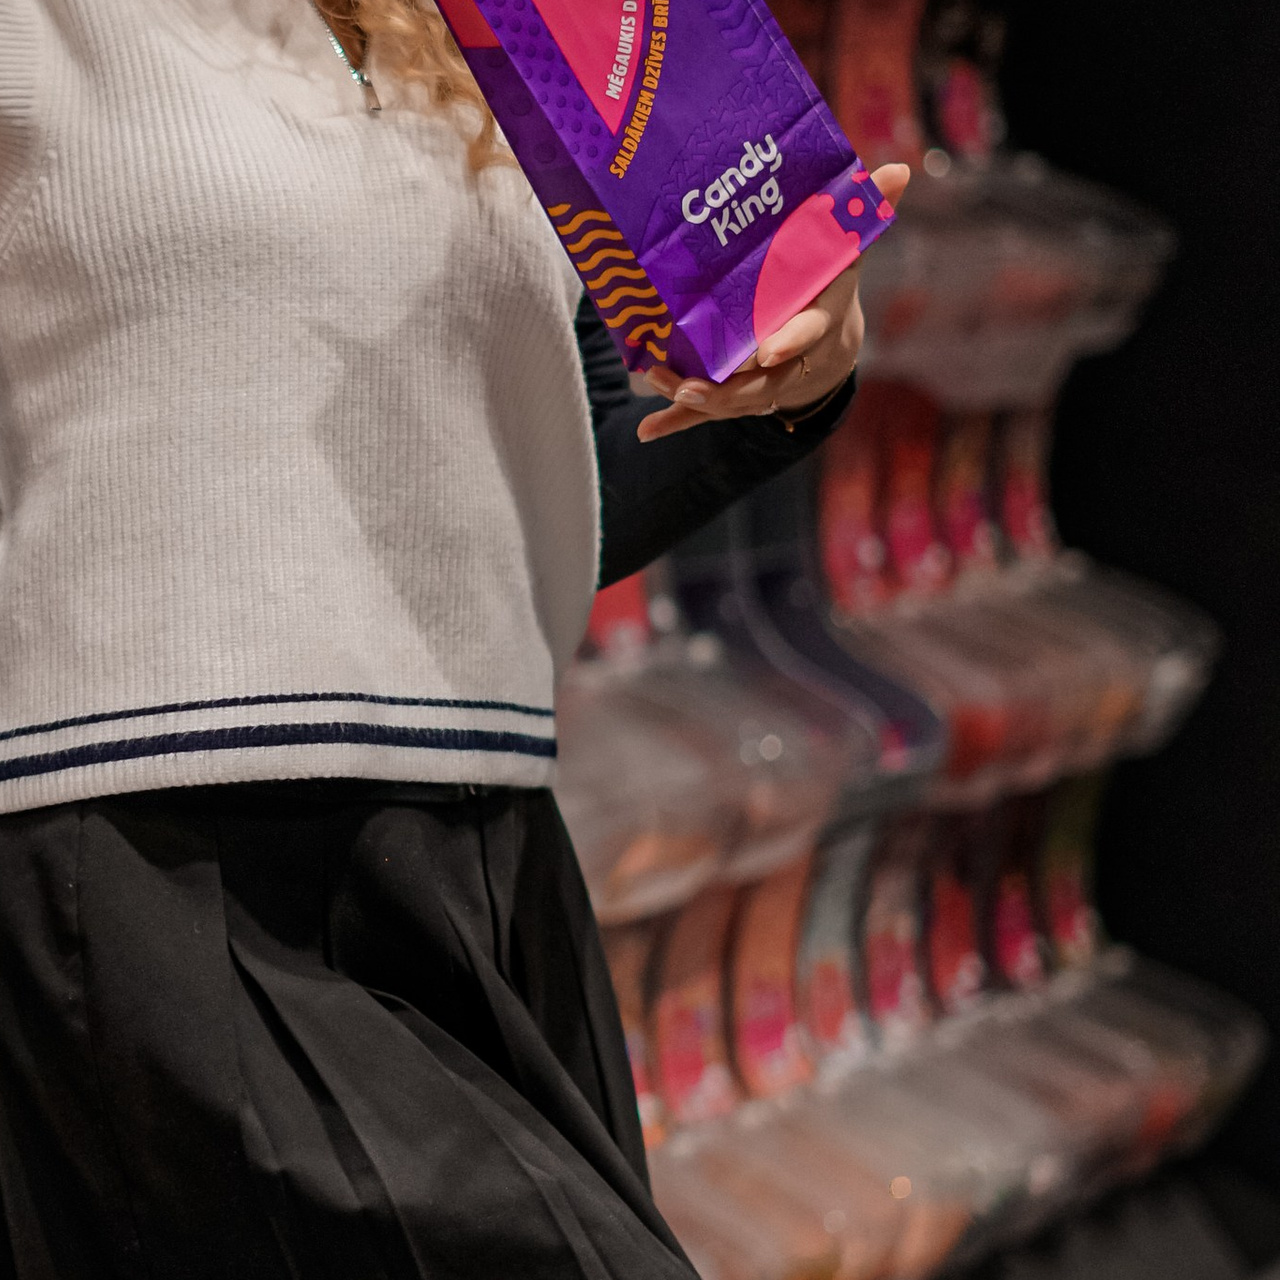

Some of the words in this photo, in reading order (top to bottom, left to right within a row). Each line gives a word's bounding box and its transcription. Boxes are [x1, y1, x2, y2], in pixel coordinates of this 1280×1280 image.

[606, 16, 636, 100] MĖGAUKIS
[610, 93, 656, 179] SALDĀKIEM
[642, 30, 667, 91] DZĪVES
[682, 133, 783, 225] Candy
[710, 176, 784, 247] King
